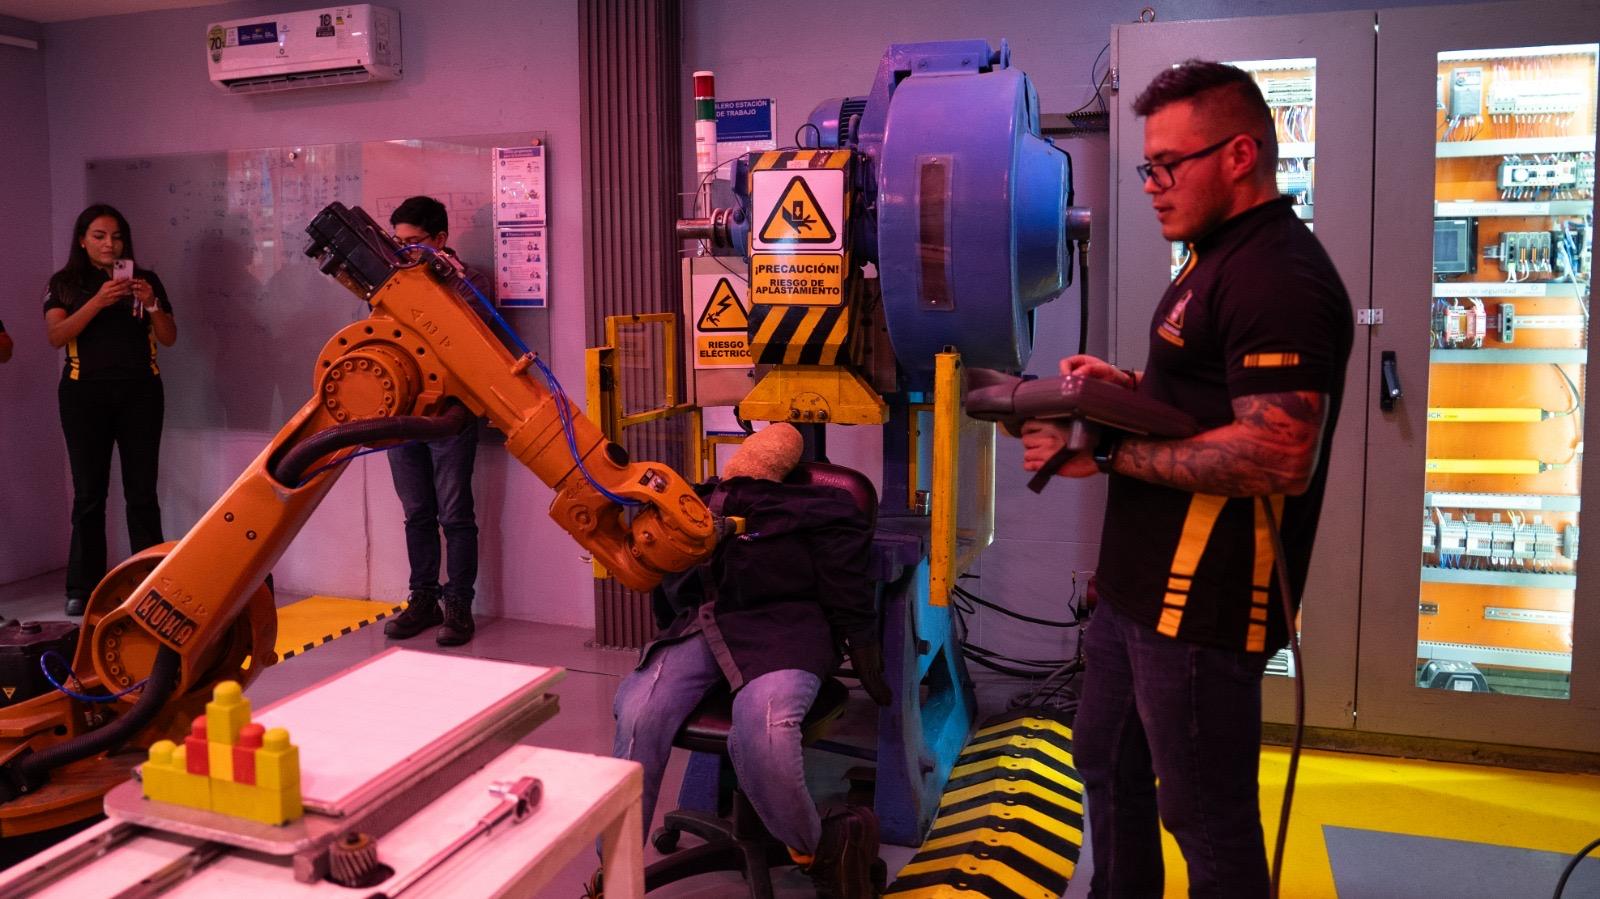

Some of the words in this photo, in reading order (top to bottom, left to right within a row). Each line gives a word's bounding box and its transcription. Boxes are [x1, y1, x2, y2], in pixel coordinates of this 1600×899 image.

[735, 100, 767, 108] ESTACIÓN
[727, 109, 756, 117] TRABAJO
[755, 262, 840, 275] ¡PRECAUCIÓN!
[770, 279, 808, 287] RIESGO
[810, 279, 824, 287] DE
[755, 286, 840, 295] APLASTAMIENTO
[136, 593, 194, 646] KUKA
